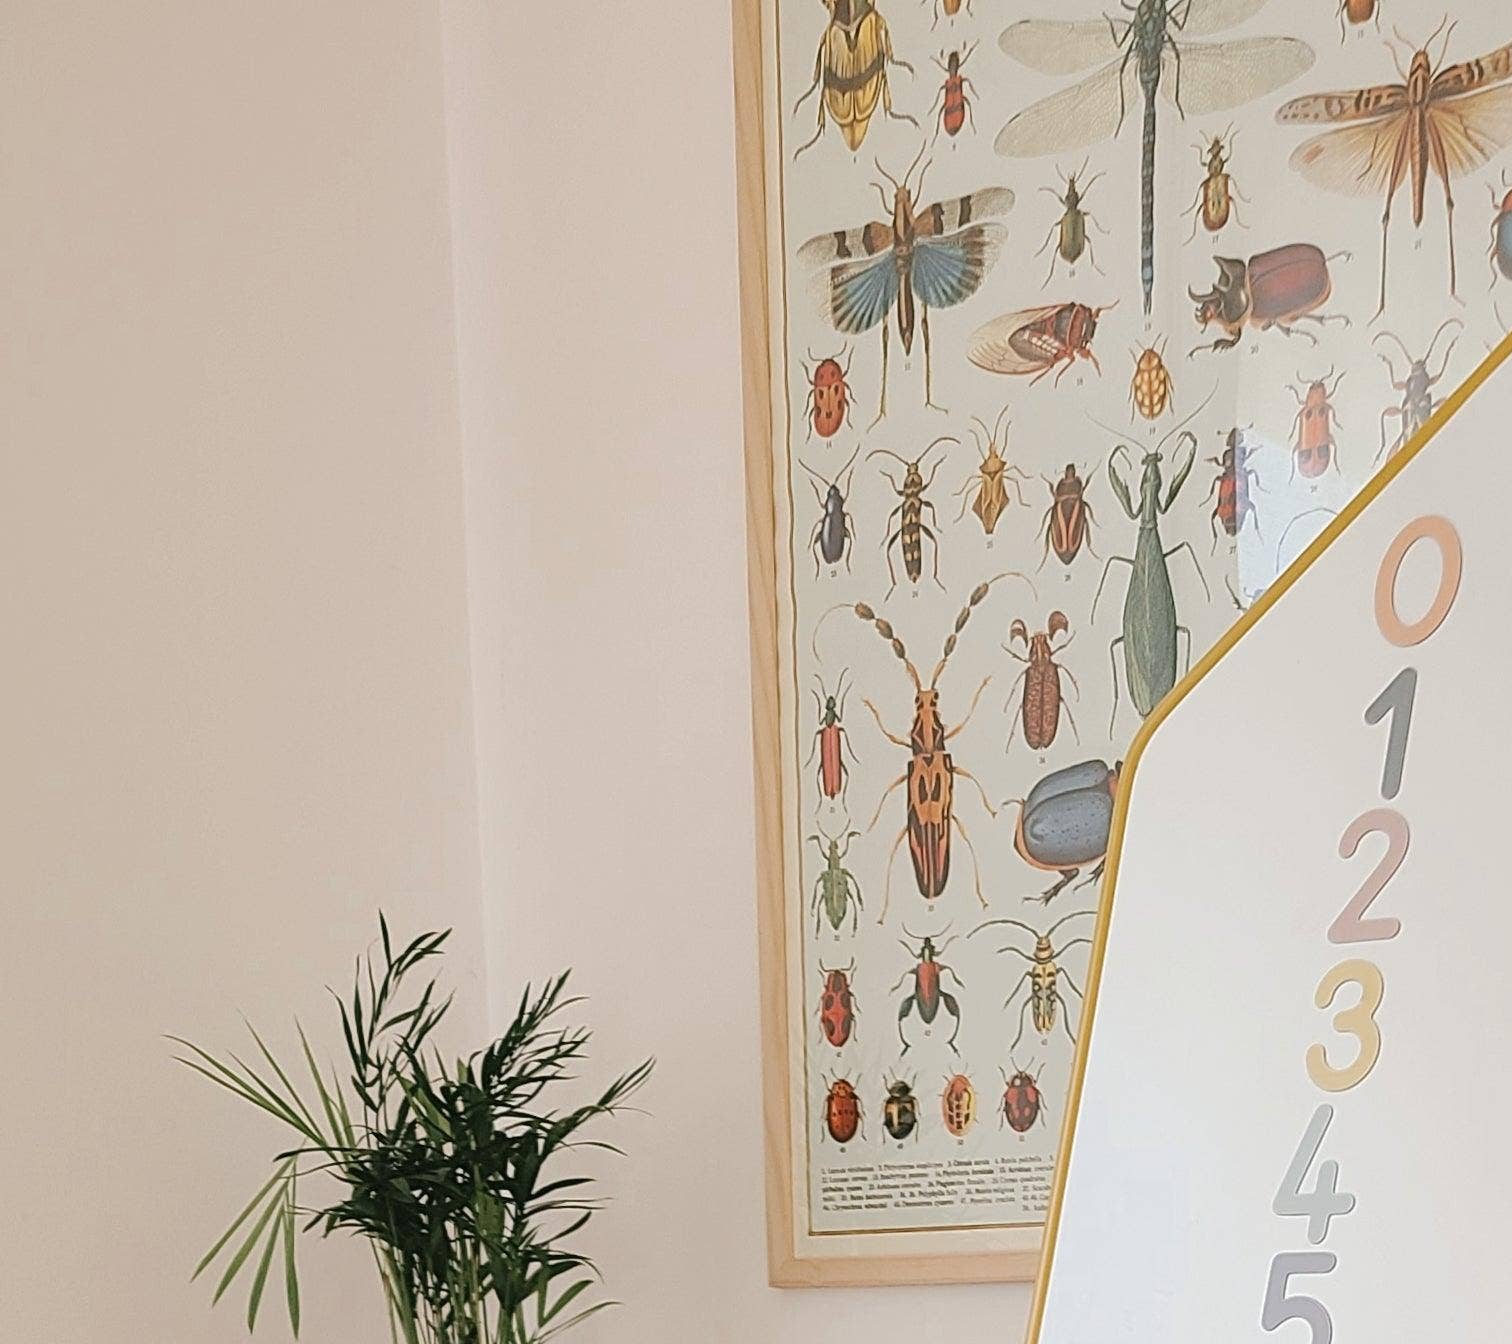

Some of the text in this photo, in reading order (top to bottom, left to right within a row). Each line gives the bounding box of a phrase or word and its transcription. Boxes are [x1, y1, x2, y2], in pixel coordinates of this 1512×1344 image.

[1374, 515, 1462, 646] 0
[1364, 666, 1418, 800] 1
[1327, 808, 1410, 944] 2
[1305, 959, 1384, 1092] 3
[1272, 1104, 1355, 1244] 4
